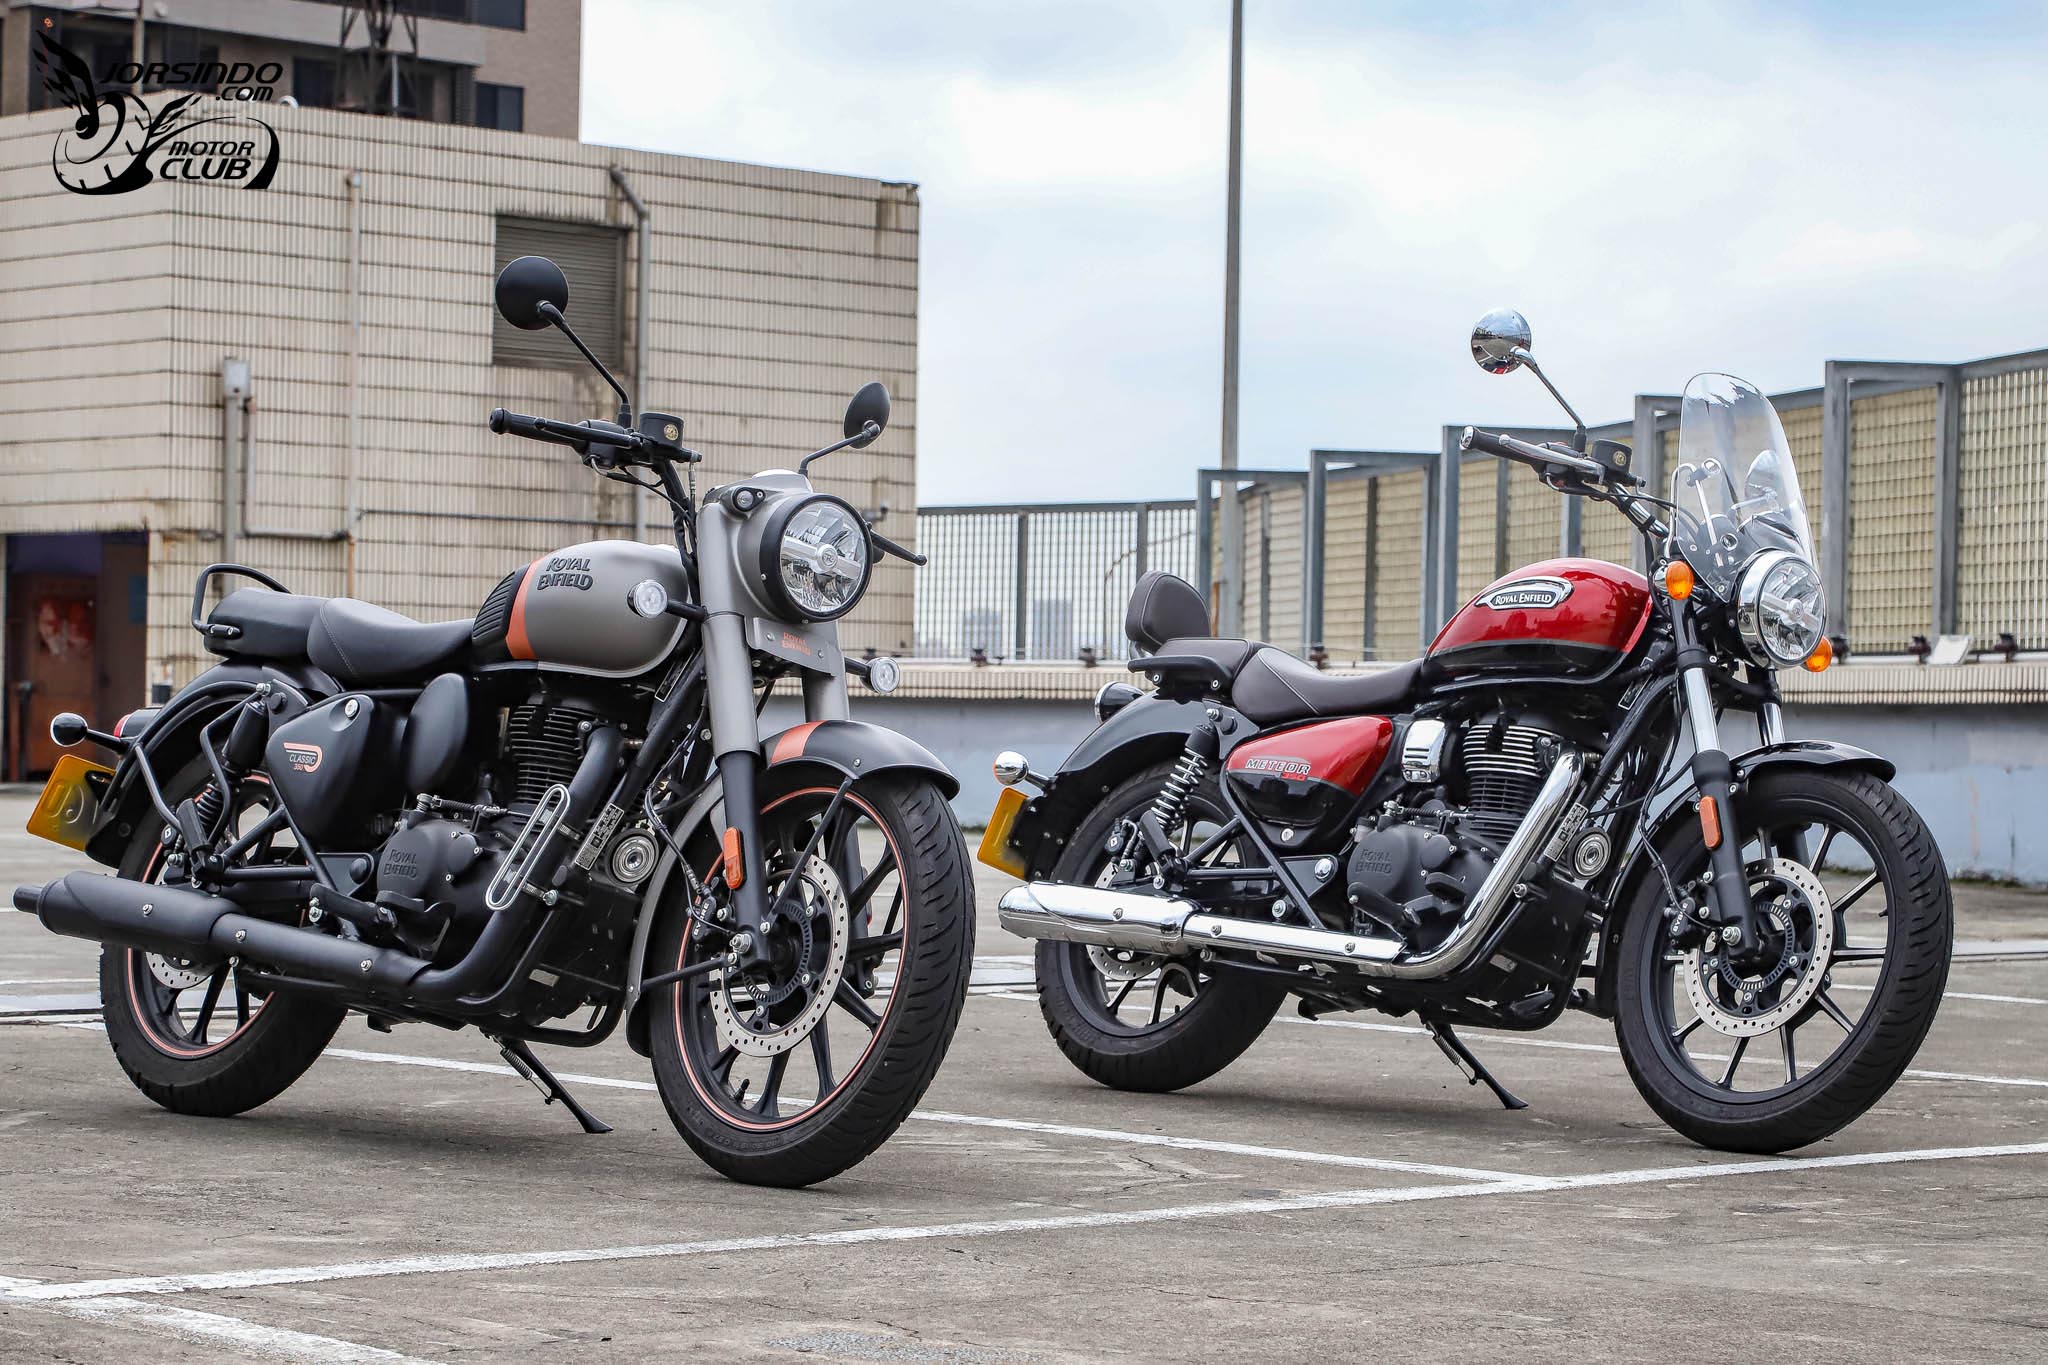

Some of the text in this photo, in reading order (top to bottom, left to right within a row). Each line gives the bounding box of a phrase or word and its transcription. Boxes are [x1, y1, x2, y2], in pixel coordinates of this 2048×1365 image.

[546, 557, 591, 572] ROYAL
[537, 572, 593, 591] ENFIELD
[1495, 593, 1552, 605] ROYAL ENFIELD
[289, 754, 316, 765] CLASSIC
[1245, 758, 1311, 775] METEOR
